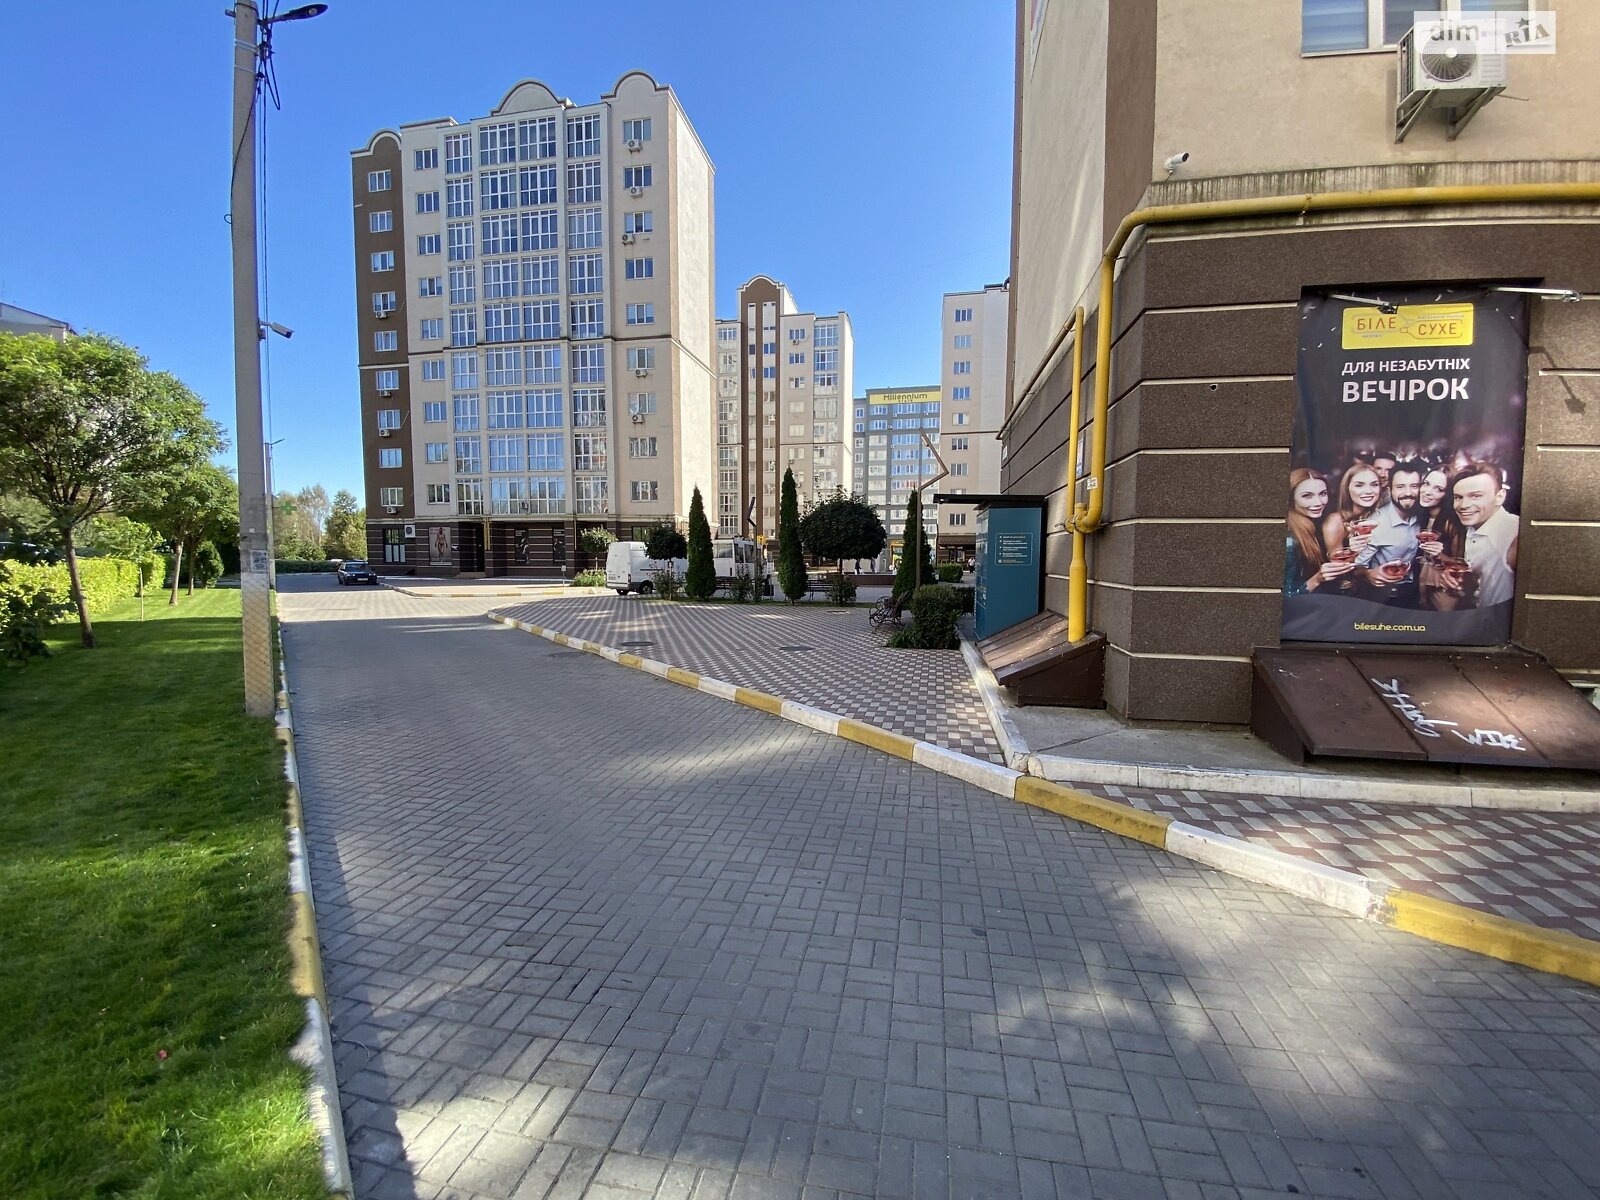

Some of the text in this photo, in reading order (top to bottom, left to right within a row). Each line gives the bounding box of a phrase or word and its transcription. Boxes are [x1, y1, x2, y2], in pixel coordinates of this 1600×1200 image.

[1357, 317, 1397, 331] БІЛЕ
[1418, 323, 1457, 336] СУХЕ
[1341, 358, 1471, 376] ДЛЯ НЕЗАБУТНІХ
[1342, 377, 1469, 403] ВЕЧІРОК
[1354, 622, 1426, 632] bilesuhe.com.ua
